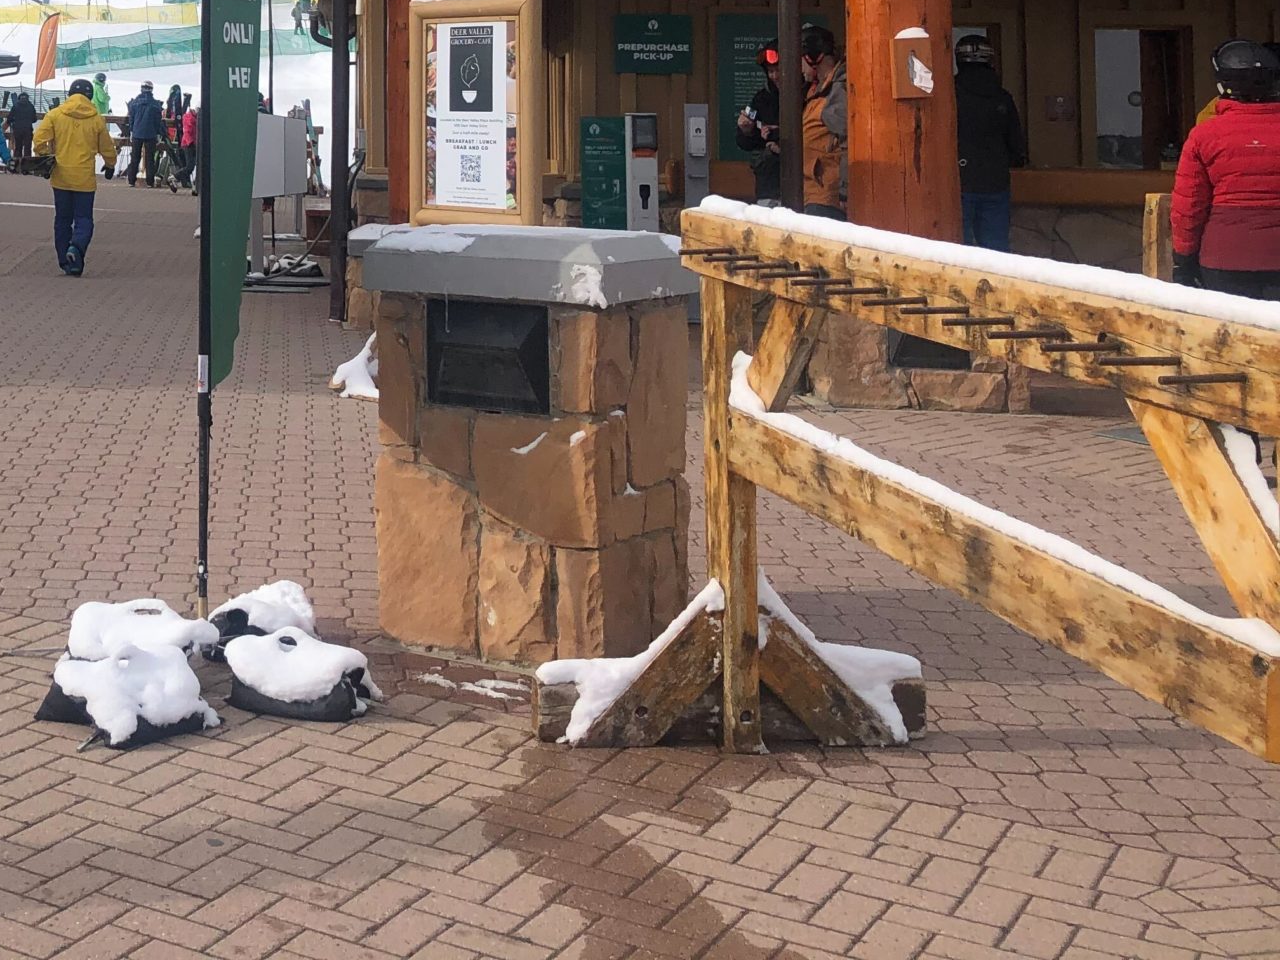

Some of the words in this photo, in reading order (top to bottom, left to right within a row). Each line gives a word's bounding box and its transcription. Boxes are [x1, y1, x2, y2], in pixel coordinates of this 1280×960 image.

[451, 28, 467, 36] DEER
[468, 27, 491, 35] VALLEY
[617, 43, 690, 52] PREPURCHASE
[633, 52, 674, 61] PICK-UP
